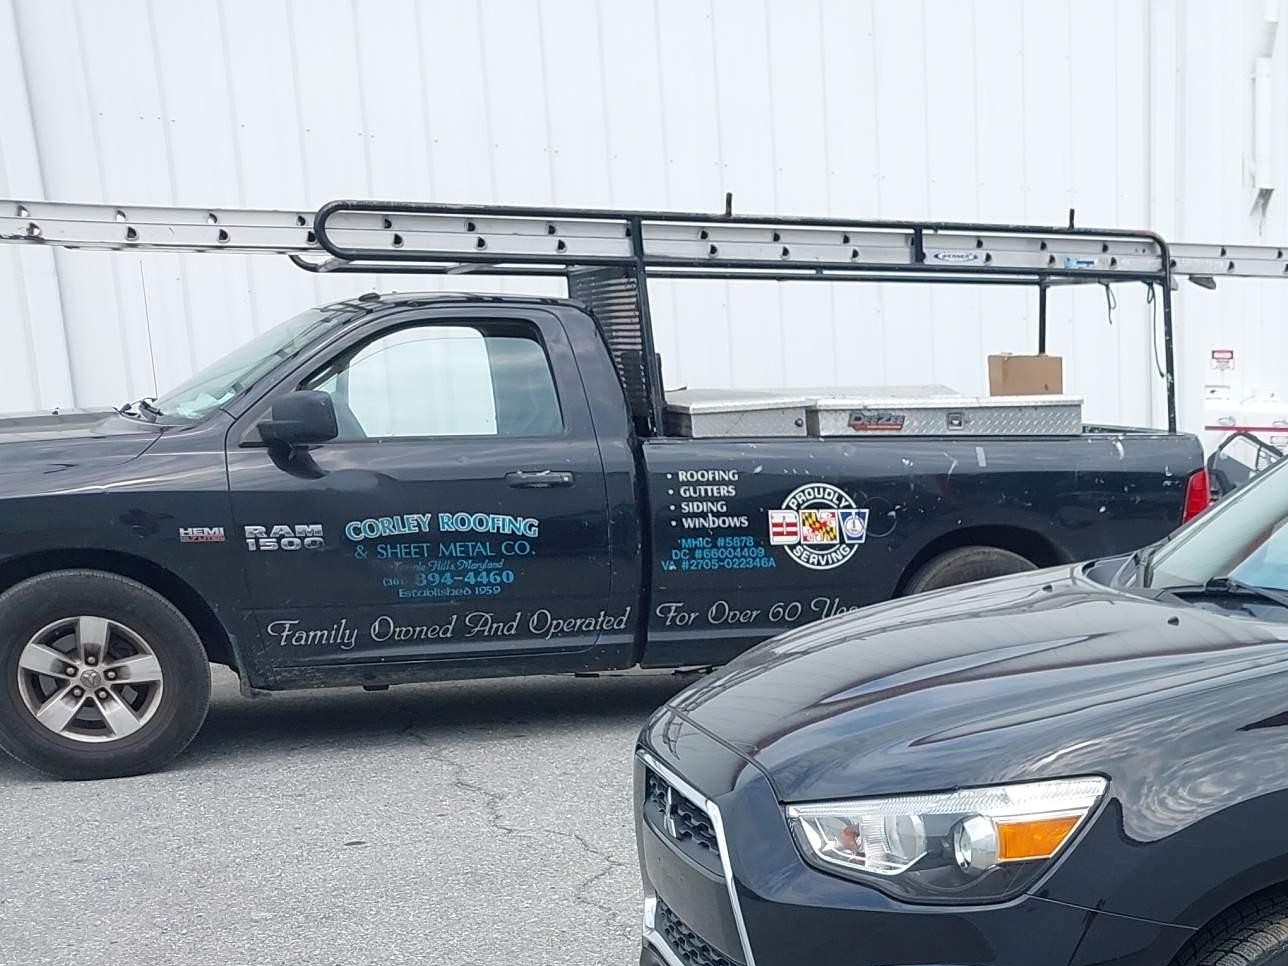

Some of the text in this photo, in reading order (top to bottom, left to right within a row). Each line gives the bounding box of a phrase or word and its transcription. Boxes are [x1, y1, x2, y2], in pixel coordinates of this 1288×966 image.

[678, 469, 739, 482] ROOFING
[680, 485, 736, 498] GUTTERS
[788, 487, 850, 511] PROUDLY
[681, 500, 728, 513] SIDING
[345, 512, 540, 541] CORLEY ROOFING
[682, 515, 749, 529] WINDOWS
[179, 527, 225, 536] HEMI
[244, 524, 324, 538] RAM
[246, 537, 325, 551] 1500
[354, 540, 537, 559] & SHEET METAL CO.
[681, 536, 754, 549] MHIC #5878
[671, 546, 765, 560] DC #66004409
[793, 543, 851, 566] SERVING
[457, 558, 505, 571] Maryland
[661, 560, 677, 571] VA
[416, 570, 515, 587] 394-4460
[399, 585, 501, 598] Established 1959
[655, 602, 700, 626] For
[707, 600, 761, 624] Over
[768, 601, 802, 622] 60
[267, 606, 632, 650] Family Owned And Operated
